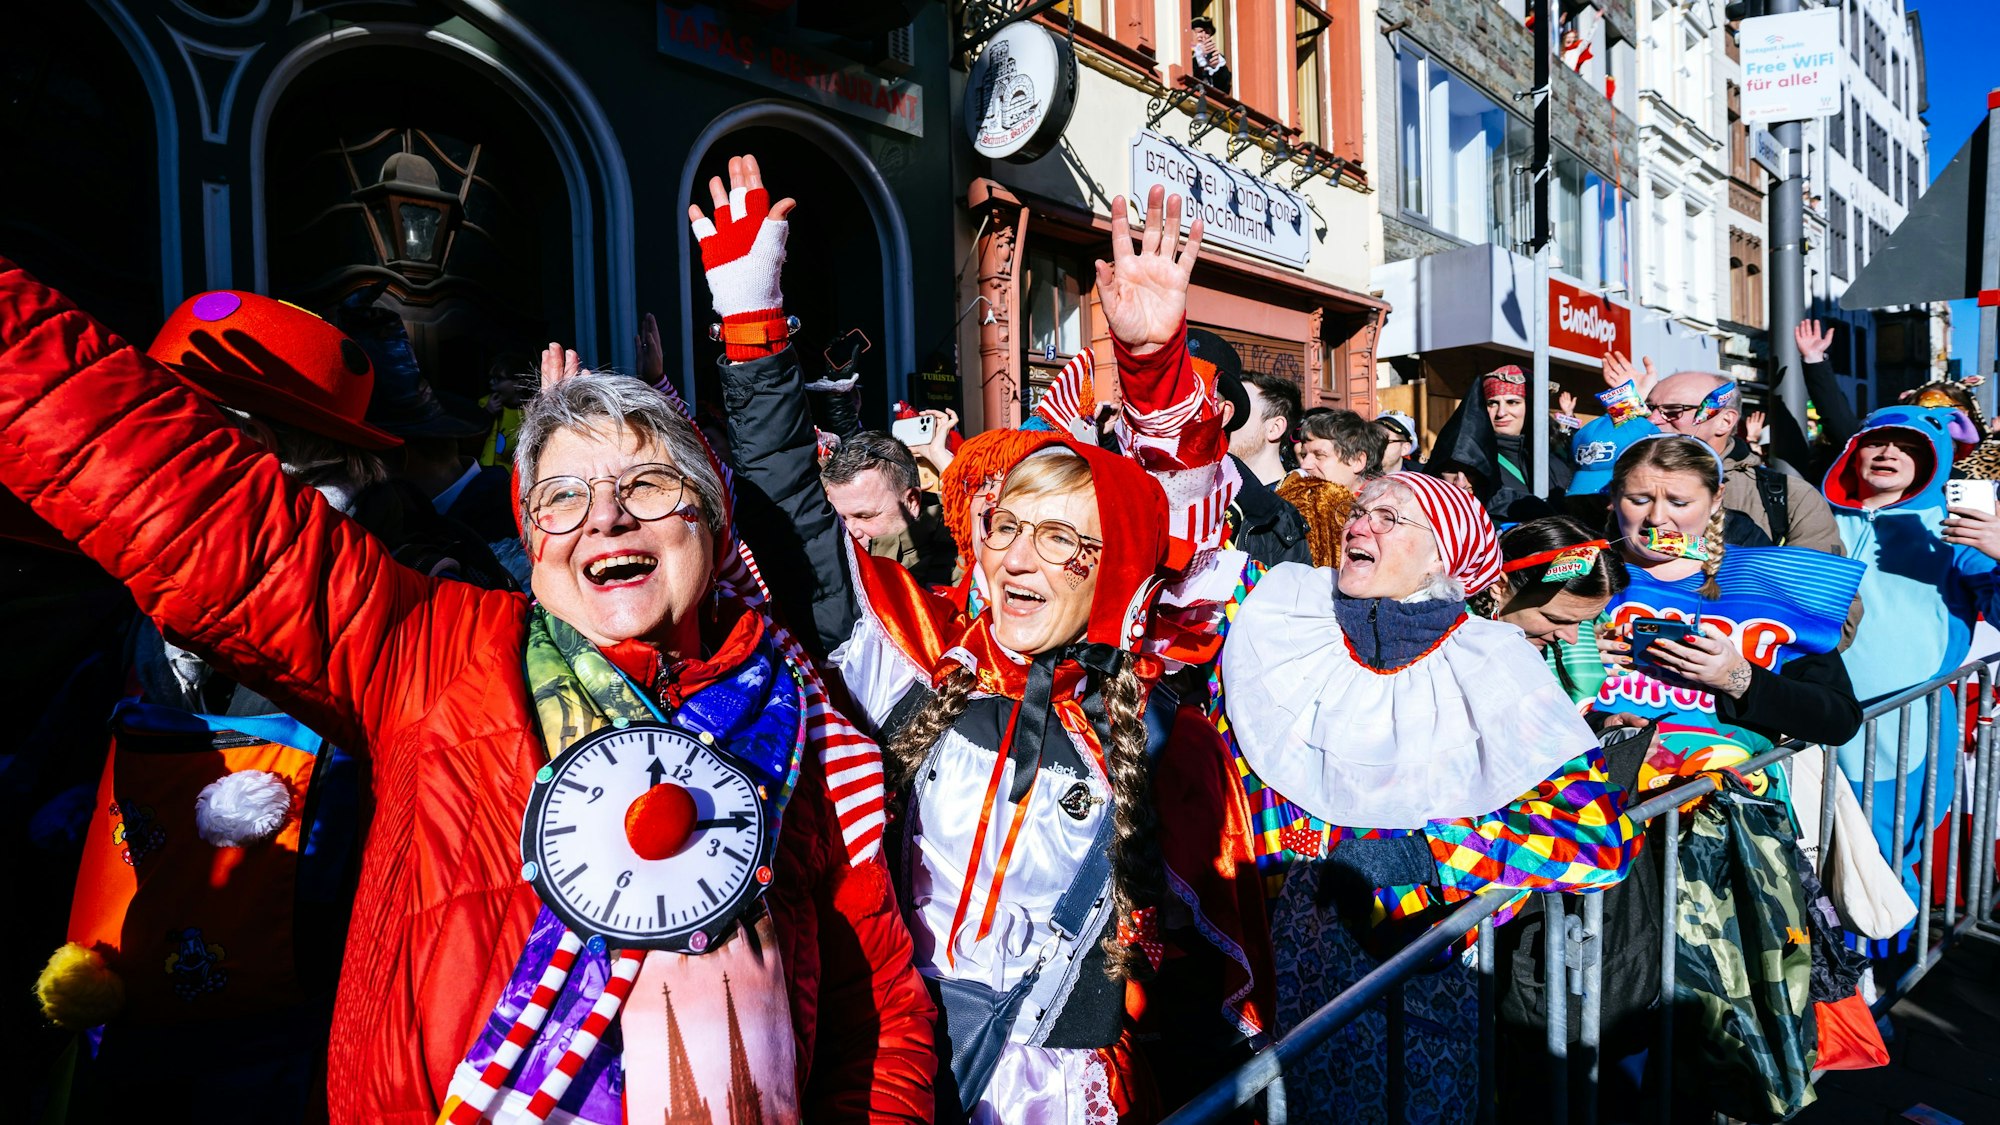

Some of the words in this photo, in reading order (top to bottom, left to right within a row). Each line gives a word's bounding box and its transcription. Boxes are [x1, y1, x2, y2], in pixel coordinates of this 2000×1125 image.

[664, 7, 754, 65] TAPAS
[770, 47, 918, 122] RESTAURANT
[1746, 61, 1787, 75] Free
[1793, 52, 1834, 69] WiFi
[1747, 79, 1772, 92] für
[1778, 71, 1818, 88] alle!
[1145, 150, 1217, 196] BÄCKEREI
[1047, 346, 1055, 360] 5
[922, 372, 956, 382] TURISTA
[1546, 563, 1581, 576] HARIBO
[670, 764, 693, 785] 12
[1048, 761, 1078, 778] Jack
[586, 786, 604, 804] 9
[706, 838, 721, 857] 3
[616, 870, 633, 888] 6
